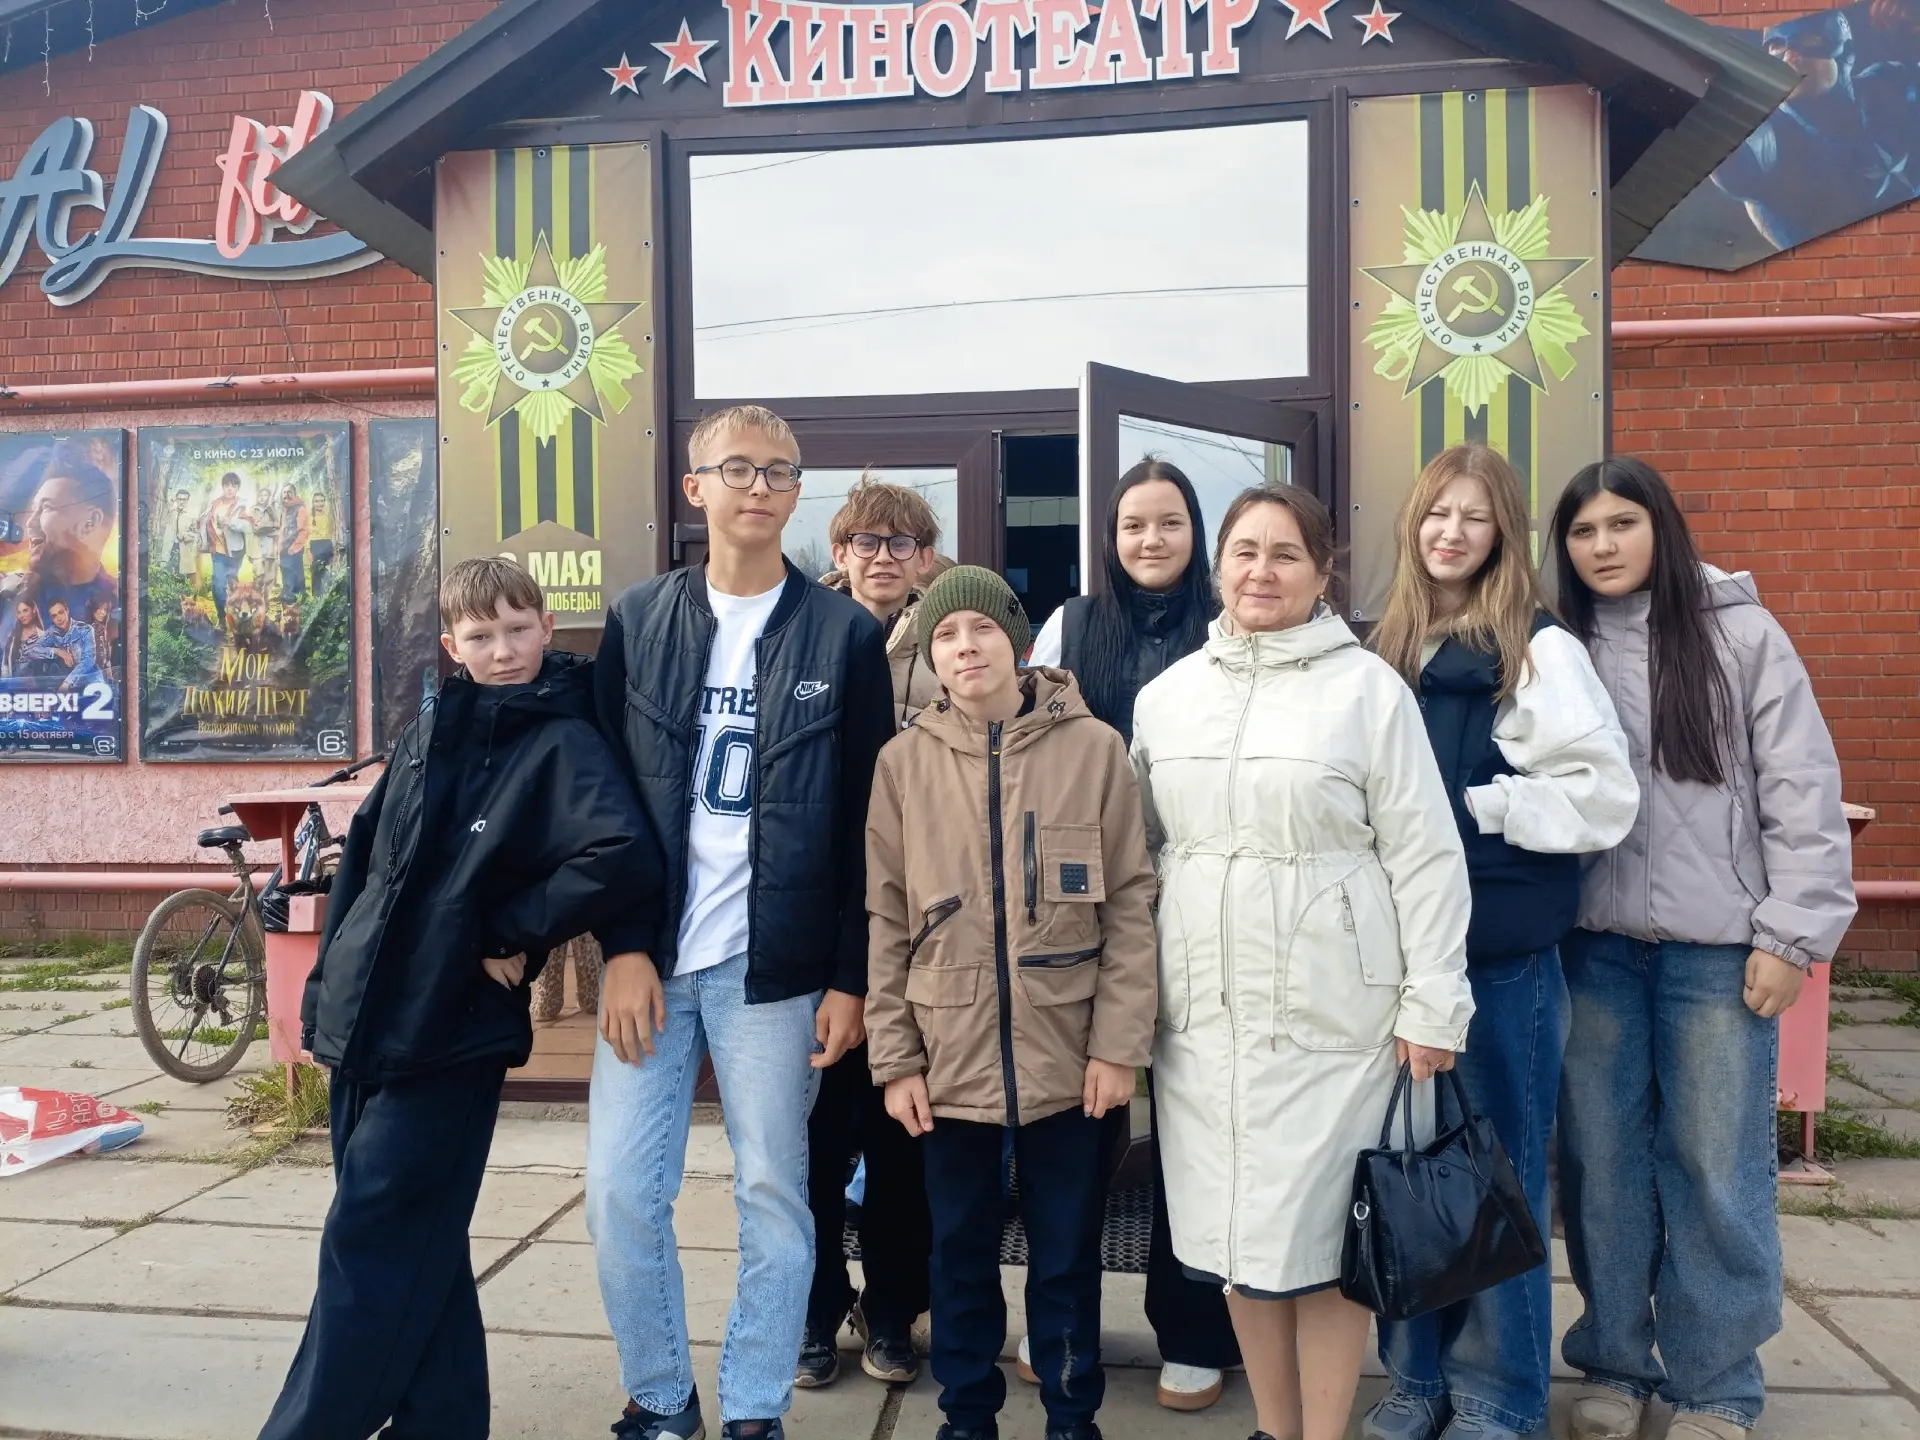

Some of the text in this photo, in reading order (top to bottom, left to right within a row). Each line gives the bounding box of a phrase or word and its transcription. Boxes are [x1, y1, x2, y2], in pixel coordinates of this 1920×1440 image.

[723, 0, 1258, 106] КИНОТЕАТР
[1420, 245, 1531, 345] ОТЕЧЕСТВЕННАЯ ВОЙНА
[498, 290, 591, 381] ОТЕЧЕСТВЕННАЯ ВОЙНА
[194, 447, 304, 459] В КИНО С 23 ИЮЛЯ
[528, 551, 602, 586] МАЯ
[546, 591, 600, 613] ПОБЕДЫ!
[82, 682, 114, 719] 2
[18, 729, 29, 739] 15
[32, 731, 74, 739] ОКТЯБРЯ
[95, 738, 116, 753] 6+
[321, 733, 348, 753] 6+
